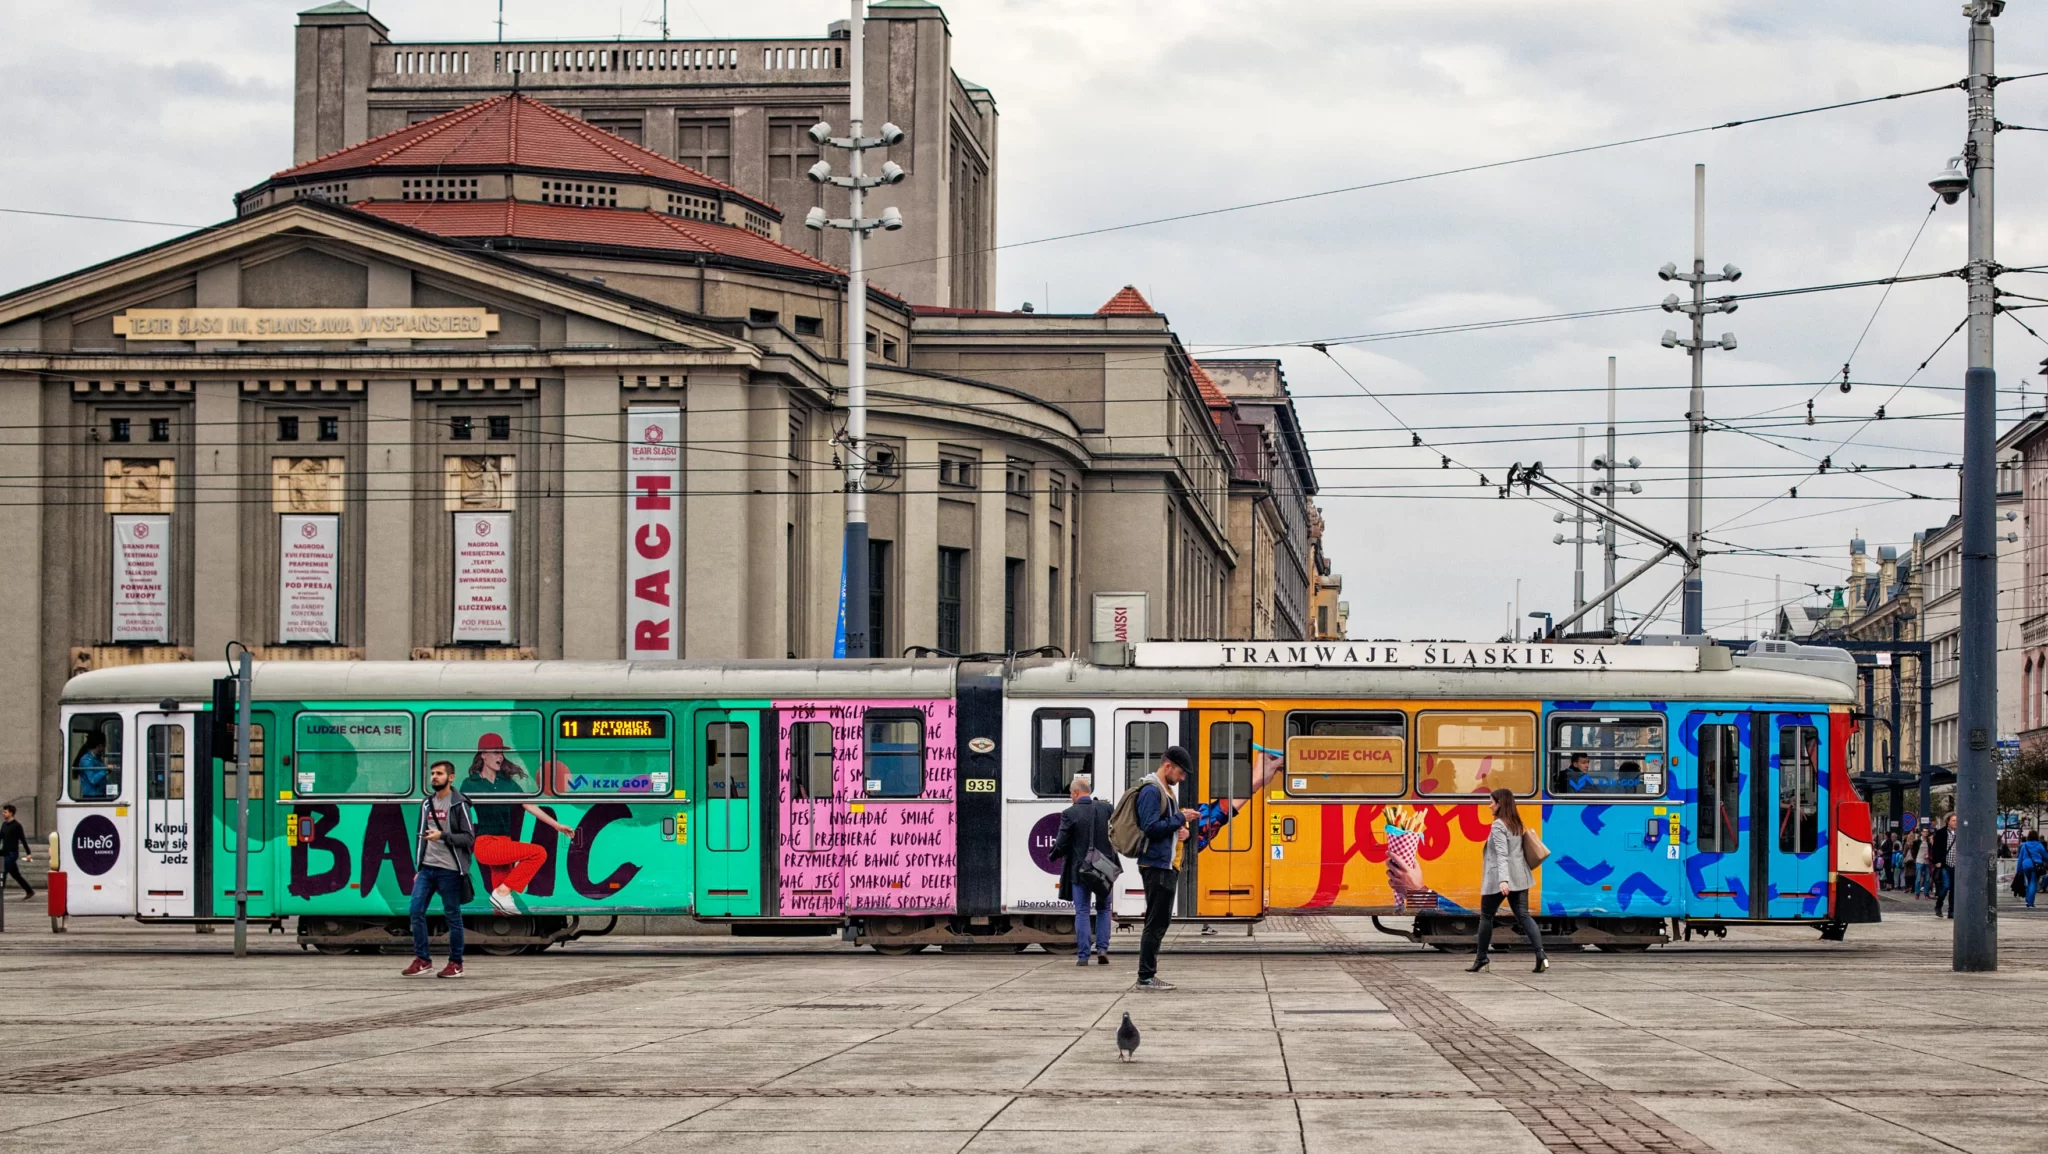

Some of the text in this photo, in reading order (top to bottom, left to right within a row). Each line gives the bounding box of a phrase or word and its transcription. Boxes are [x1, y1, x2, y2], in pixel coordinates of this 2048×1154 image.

[130, 314, 481, 335] TEATR ŚLĄSKI IM. STANISŁAWA WYSPIAŃSKIEGO
[632, 446, 676, 456] TEATR ŚLĄSKI
[635, 476, 671, 650] RACH
[1222, 644, 1613, 668] TRAMWAJE ŚLĄSKIE S.A.
[306, 725, 402, 736] LUDZIE CHCĄ SIĘ
[562, 721, 578, 736] 11
[593, 720, 650, 728] KATOWICE
[592, 728, 652, 736] PL. MIARKI
[1300, 750, 1393, 764] LUDZIE CHCĄ
[592, 780, 619, 788] KZK
[622, 780, 649, 788] GOP
[968, 780, 994, 790] 935
[791, 808, 816, 826] JEŚ
[830, 808, 888, 828] WYGLĄDAĆ
[901, 808, 934, 826] ŚMIAĆ
[155, 822, 188, 836] Kupuj
[78, 834, 113, 848] Libero
[144, 838, 188, 850] Baw się
[780, 829, 942, 846] DAĆ PRZEBIERAĆ KUPOWAĆ
[1036, 836, 1056, 848] Lib
[160, 854, 188, 864] Jedz
[784, 850, 858, 868] PRZYMIERZAĆ
[864, 850, 900, 868] BAWIĆ
[814, 872, 840, 888] JEŚĆ
[850, 872, 910, 888] SMAKOWAĆ
[792, 893, 850, 912] WYGLĄDAĆ
[856, 893, 892, 909] BAWIĆ
[898, 893, 950, 909] SPOTYKAĆ
